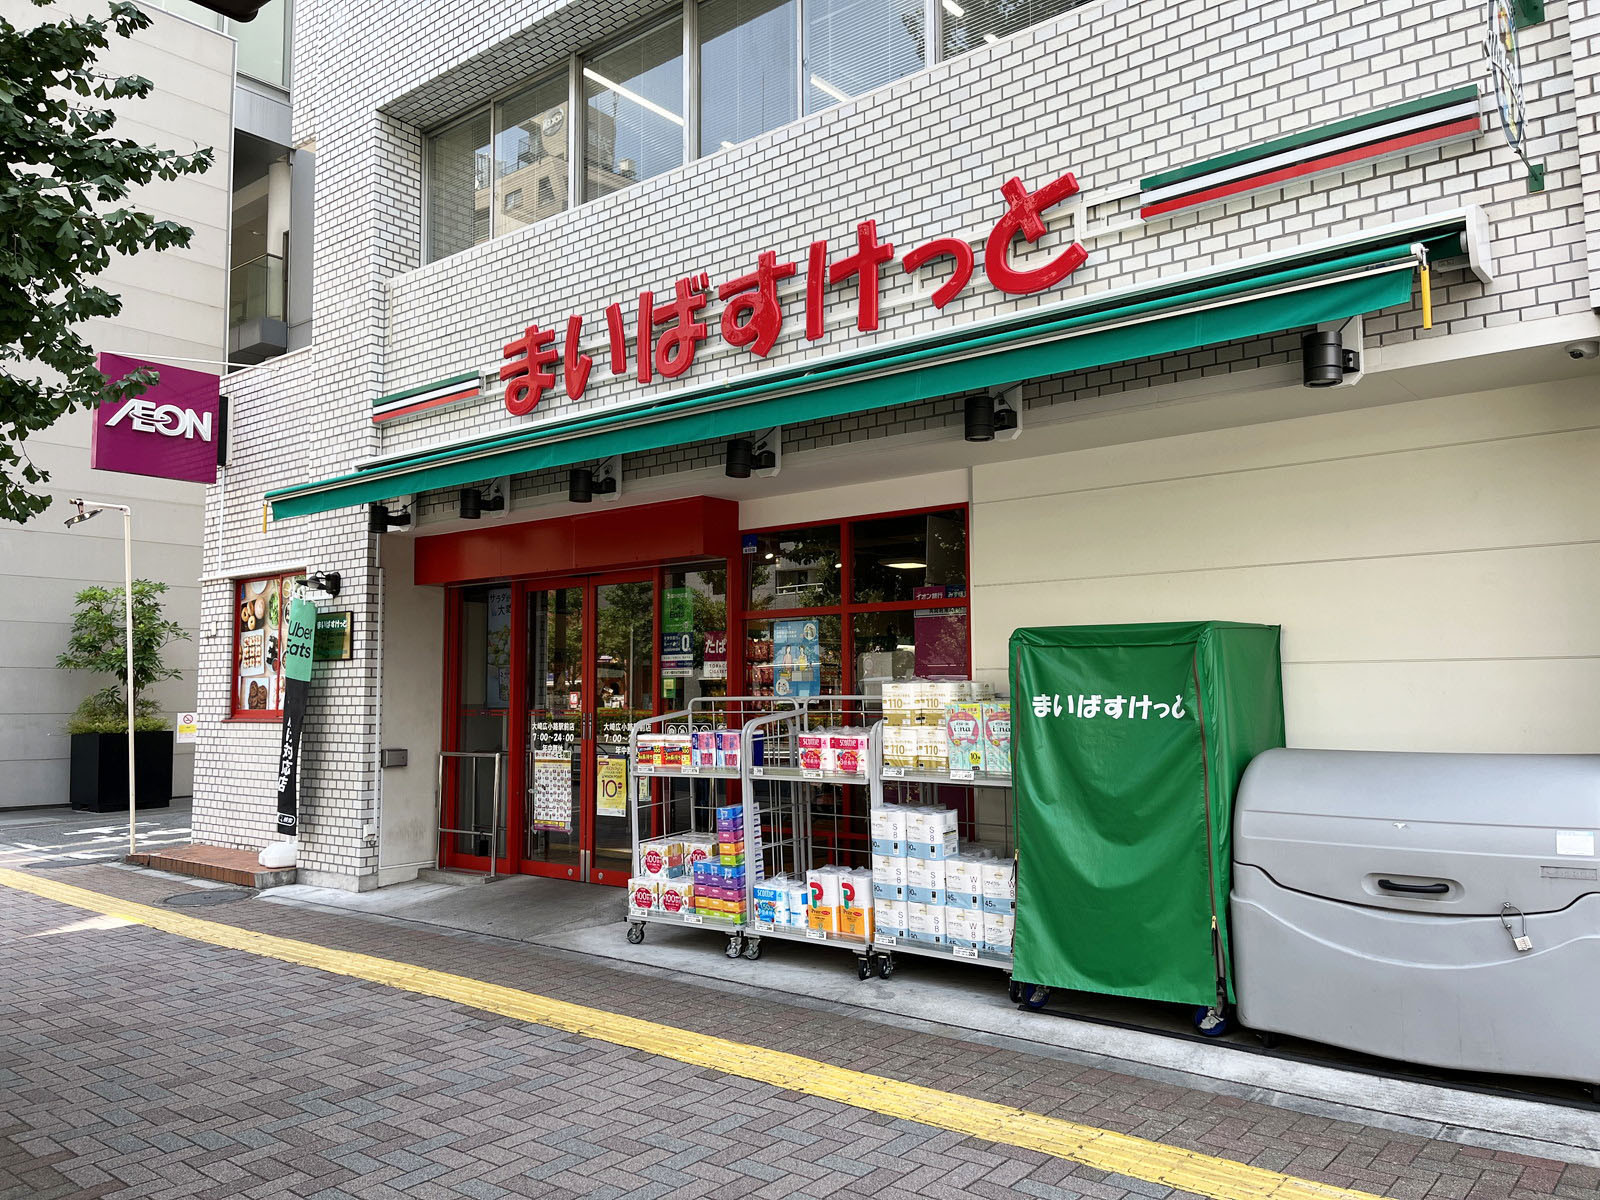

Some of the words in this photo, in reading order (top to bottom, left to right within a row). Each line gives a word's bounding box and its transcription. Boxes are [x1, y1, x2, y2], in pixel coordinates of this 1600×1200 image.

[499, 171, 1089, 416] まいばすけっと
[105, 398, 213, 442] AEON
[288, 620, 313, 640] Uber
